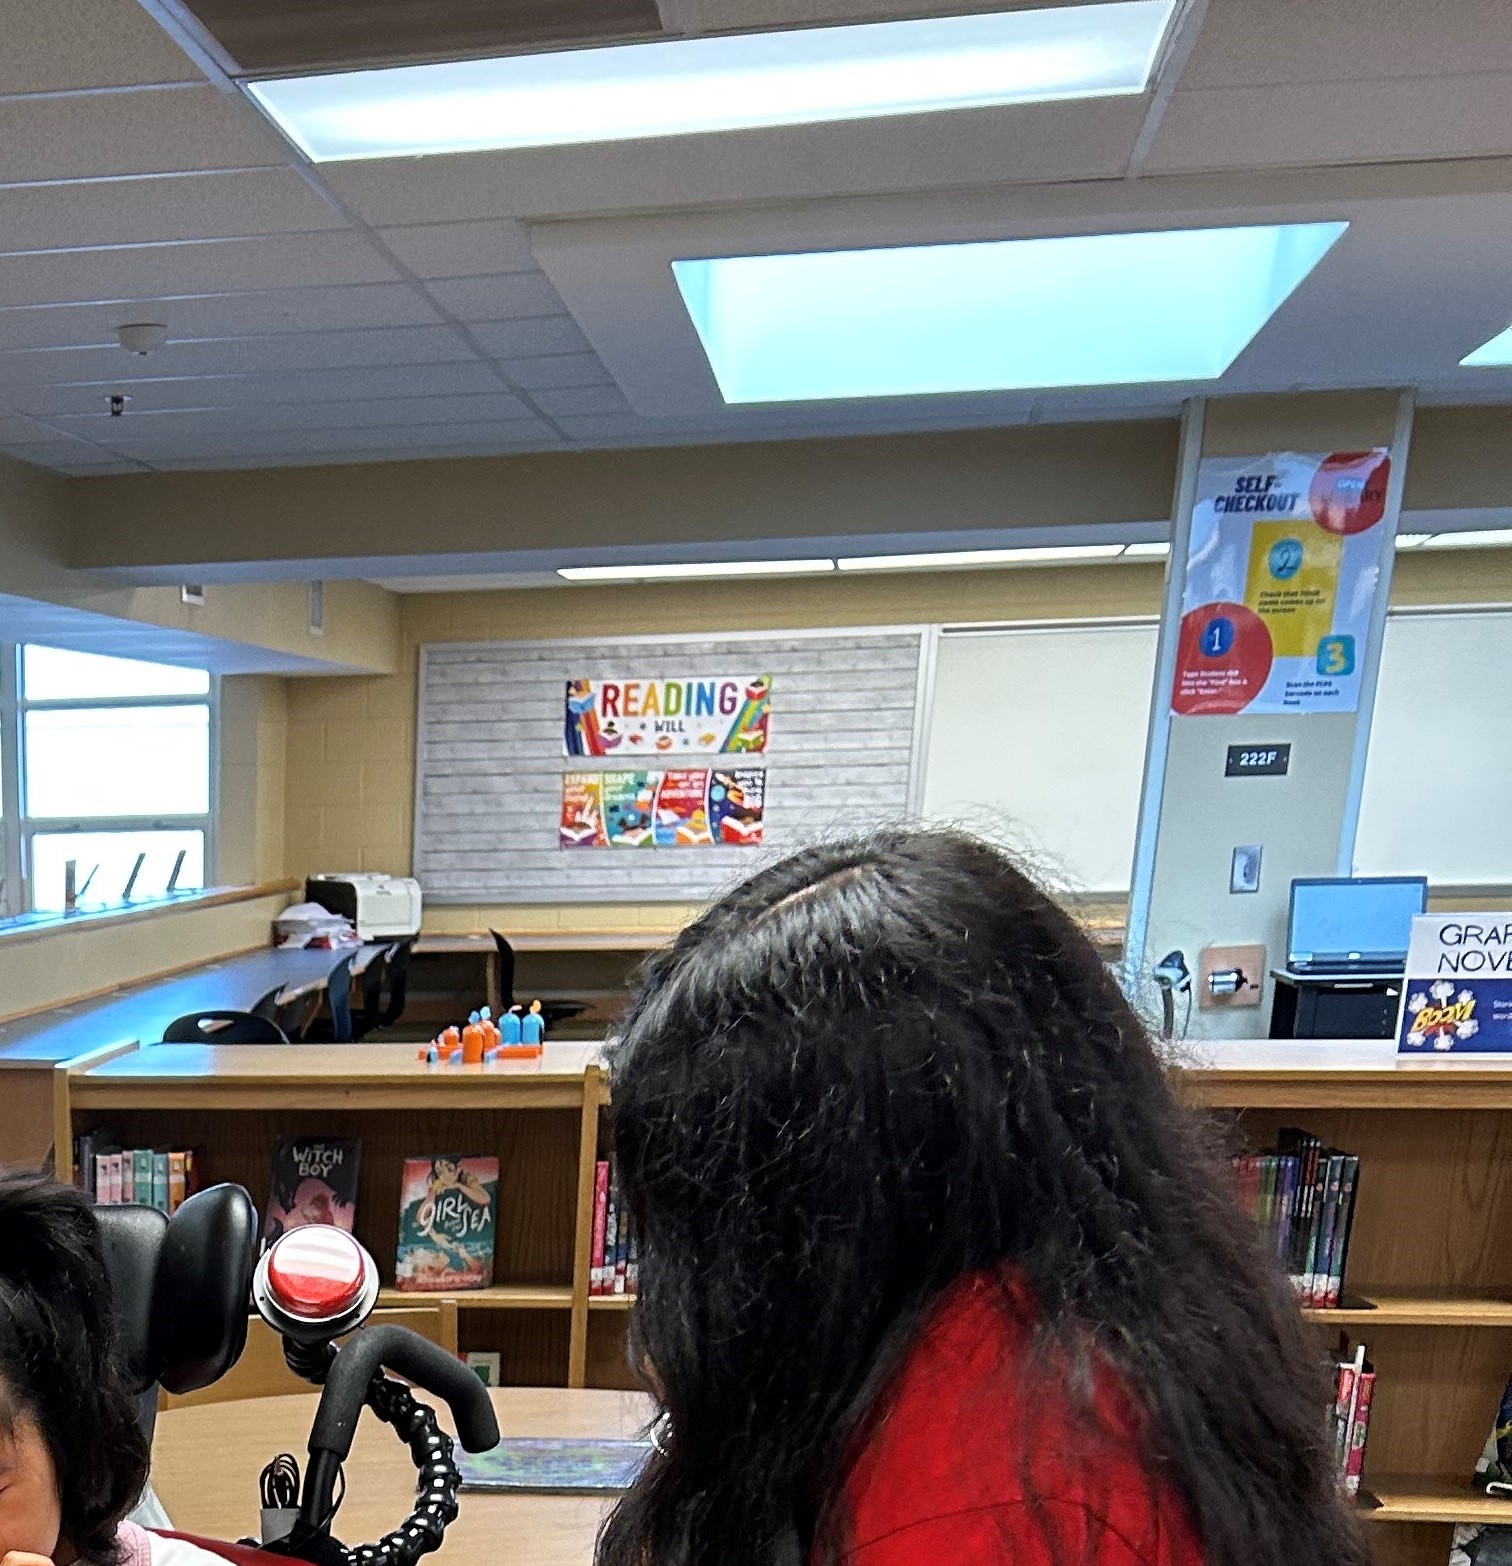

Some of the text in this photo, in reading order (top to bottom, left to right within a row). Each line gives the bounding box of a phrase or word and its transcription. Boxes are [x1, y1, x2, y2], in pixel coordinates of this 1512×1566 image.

[1235, 475, 1281, 492] SELF-
[1214, 493, 1300, 513] CHECKOUT
[1277, 547, 1298, 572] 2
[1211, 626, 1222, 651] 1
[1325, 642, 1346, 673] 3
[601, 682, 738, 718] READING
[654, 719, 686, 733] WILL
[1239, 751, 1277, 766] 222F
[292, 1146, 344, 1165] WITCH
[299, 1162, 333, 1178] BOY
